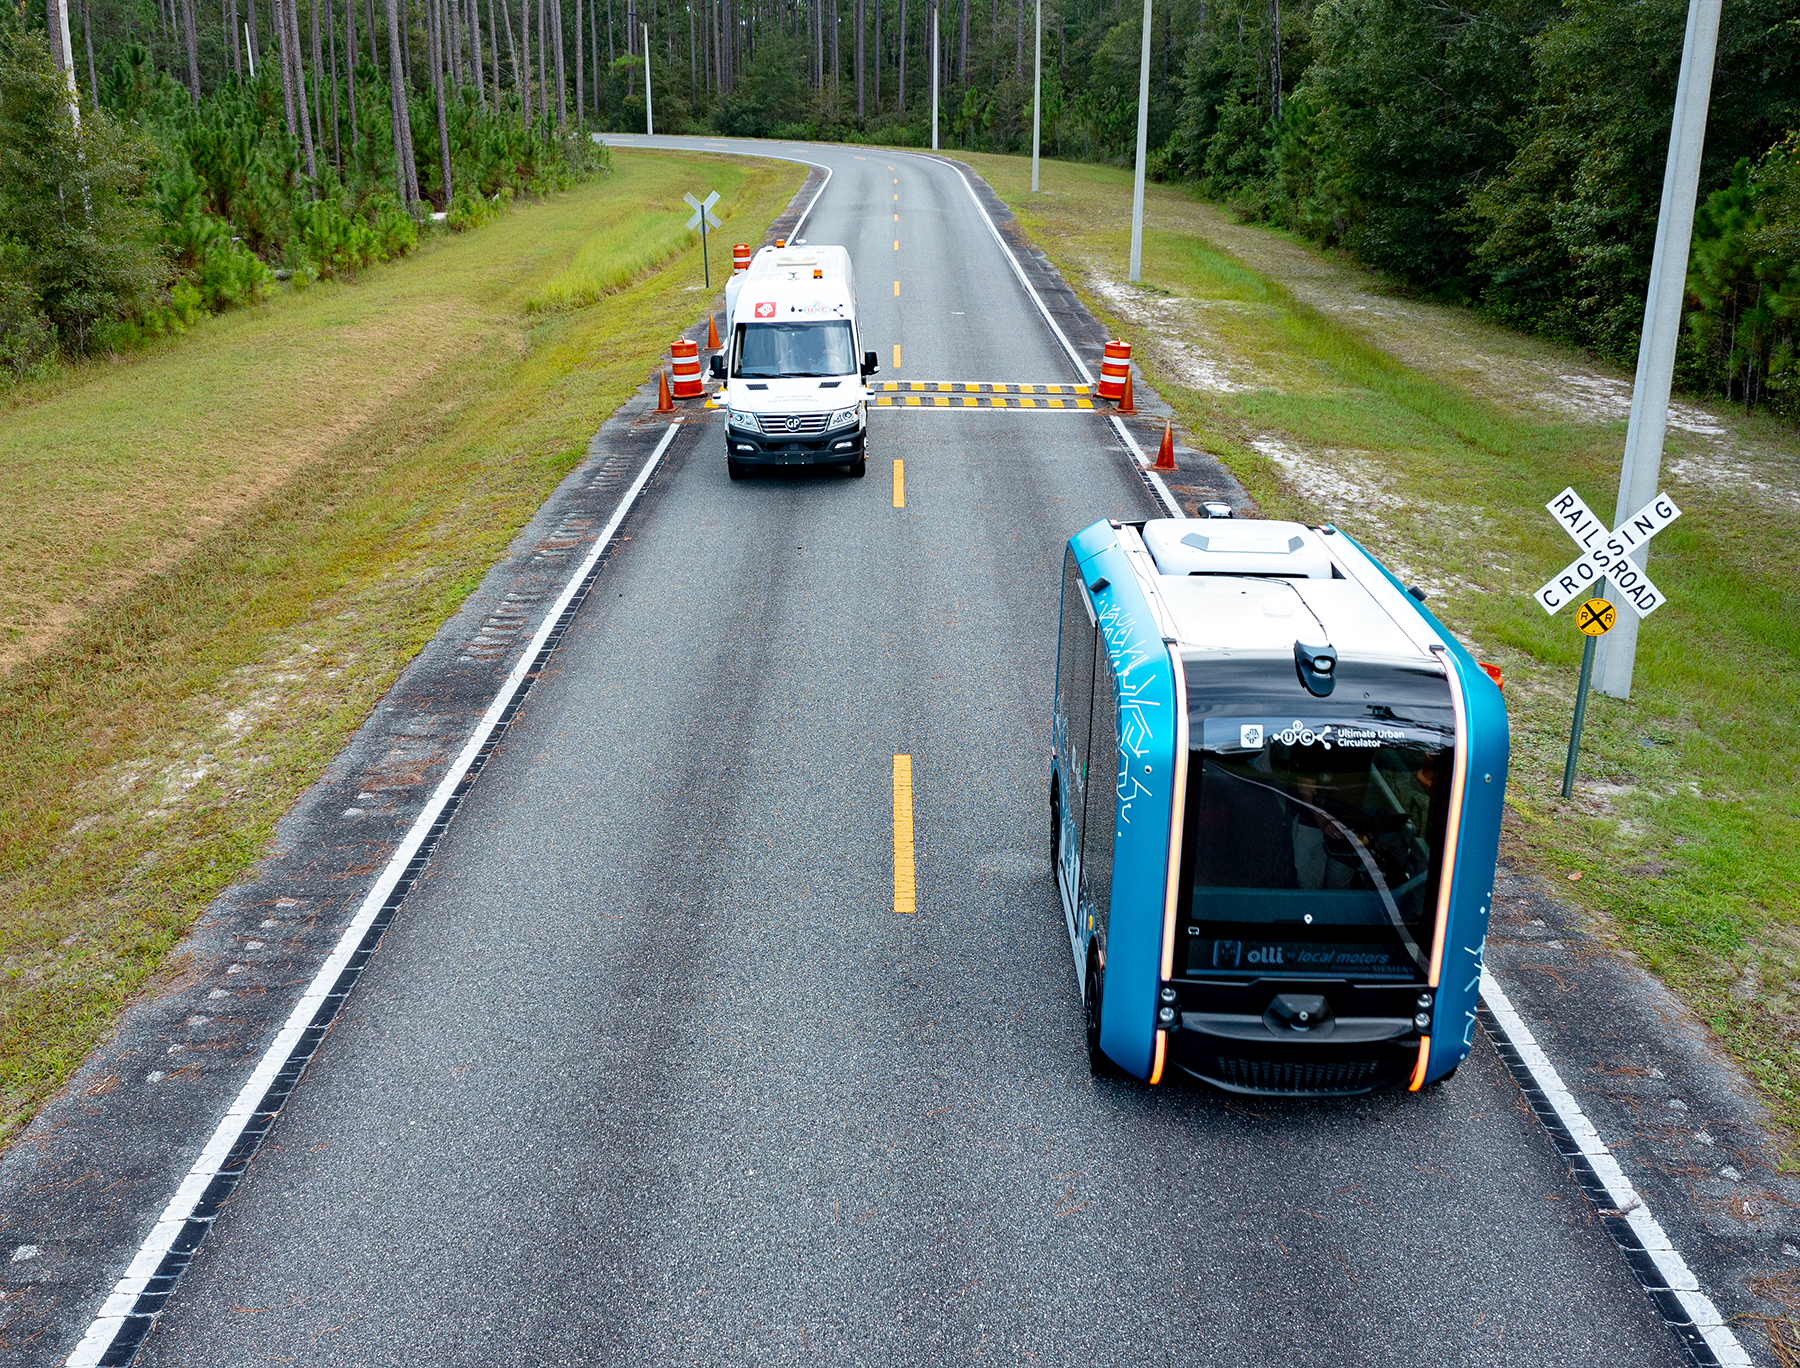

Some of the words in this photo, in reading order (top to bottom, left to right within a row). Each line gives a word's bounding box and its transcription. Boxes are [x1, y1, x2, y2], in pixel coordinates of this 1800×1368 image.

[786, 418, 800, 428] GP
[1543, 501, 1673, 607] CROSSING
[1580, 611, 1589, 621] R
[1604, 613, 1613, 623] R
[1337, 728, 1377, 739] Ultimate
[1377, 729, 1405, 739] Urban
[1337, 738, 1382, 748] Circulator
[1247, 946, 1284, 964] olli
[1297, 949, 1336, 963] local
[1336, 952, 1390, 965] motors
